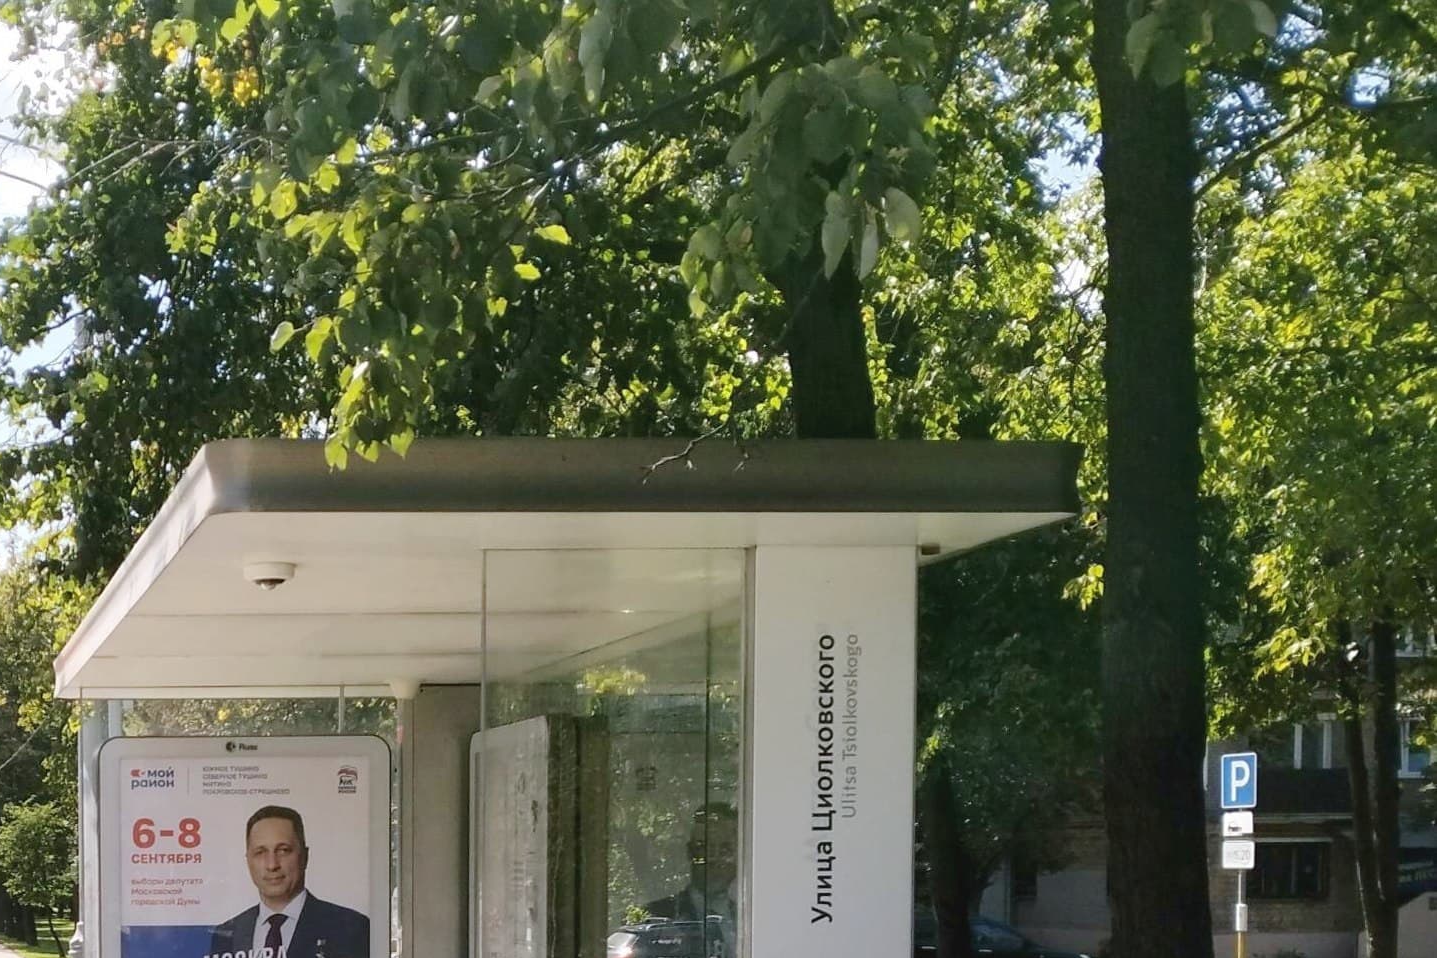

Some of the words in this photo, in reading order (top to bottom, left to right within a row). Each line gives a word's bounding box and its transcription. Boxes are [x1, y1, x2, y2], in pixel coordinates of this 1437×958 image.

[841, 633, 862, 760] Tsiolkovskogo
[811, 634, 837, 831] Циолковского
[147, 766, 175, 778] мой
[841, 765, 858, 818] Ulitsa
[1230, 760, 1251, 802] P
[132, 818, 202, 849] 6-8
[131, 852, 202, 864] СЕНТЯБРЯ
[811, 841, 836, 924] Улица
